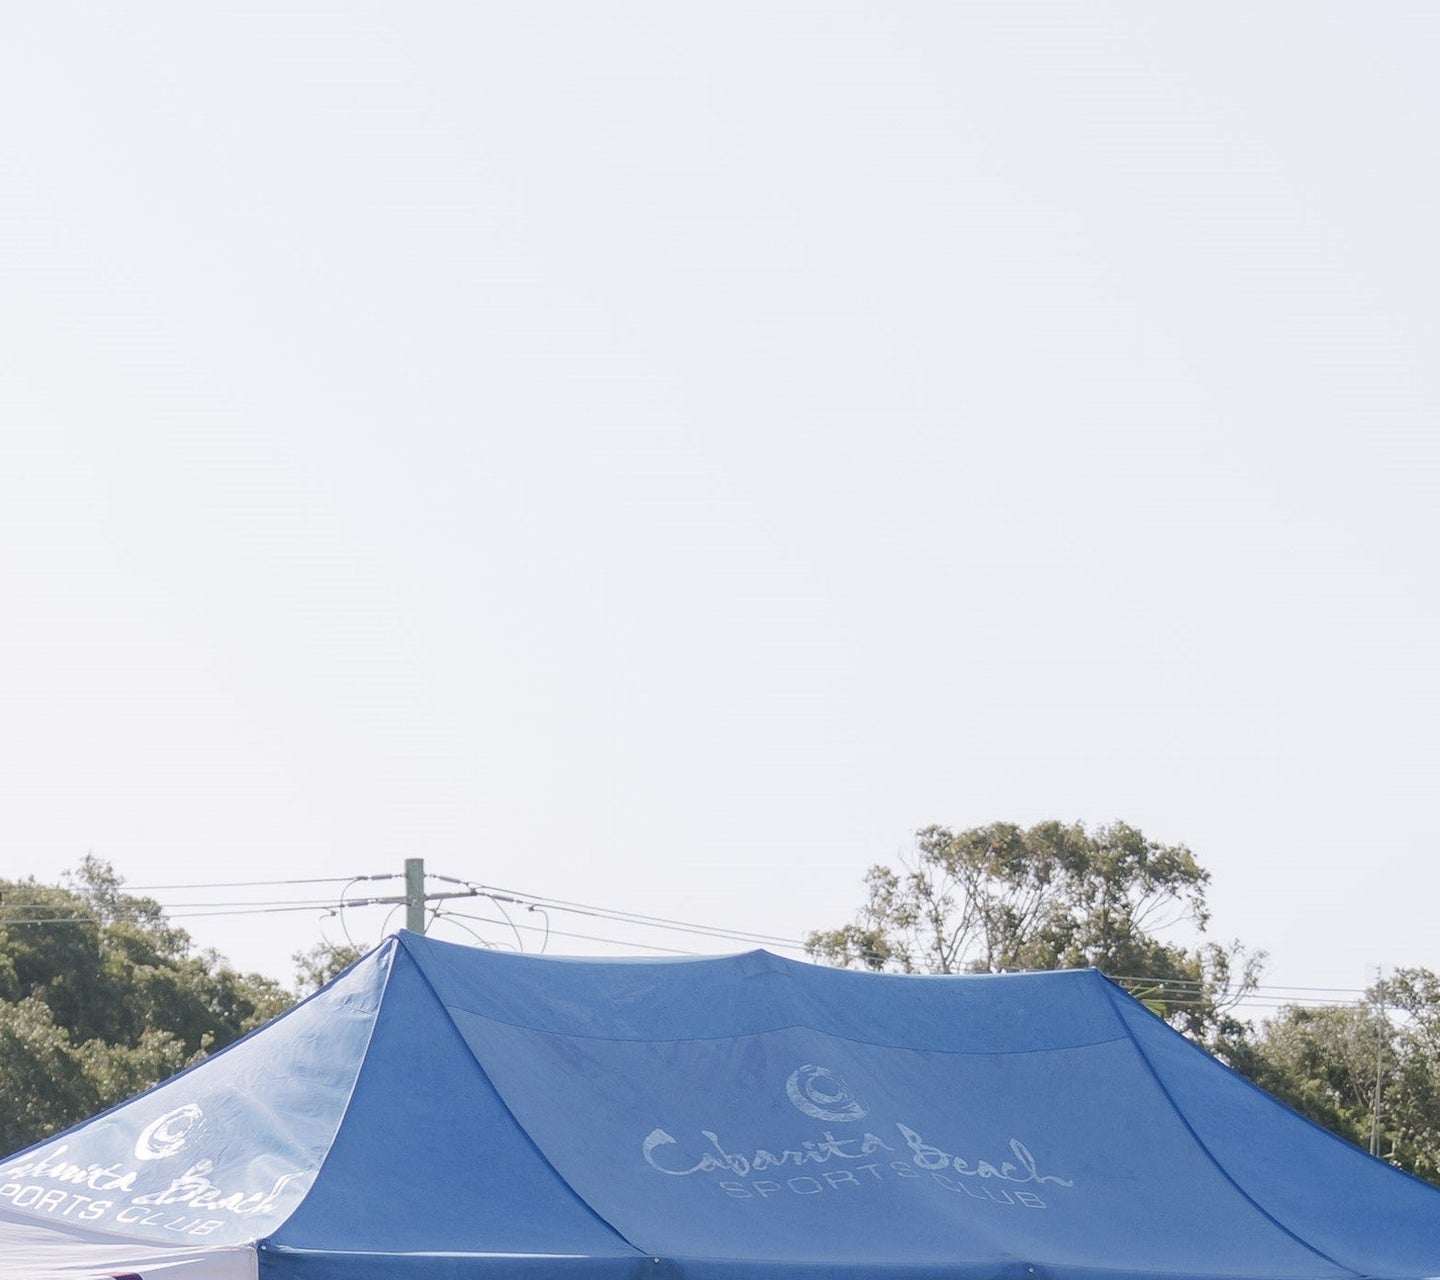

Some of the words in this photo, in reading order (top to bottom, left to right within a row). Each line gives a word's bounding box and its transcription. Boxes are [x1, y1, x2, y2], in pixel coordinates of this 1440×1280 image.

[642, 1126, 897, 1178] Cabarita
[895, 1121, 1075, 1189] Beach
[719, 1160, 921, 1199] SPORTS
[931, 1171, 1049, 1211] CLUB
[115, 1205, 228, 1237] CLUB
